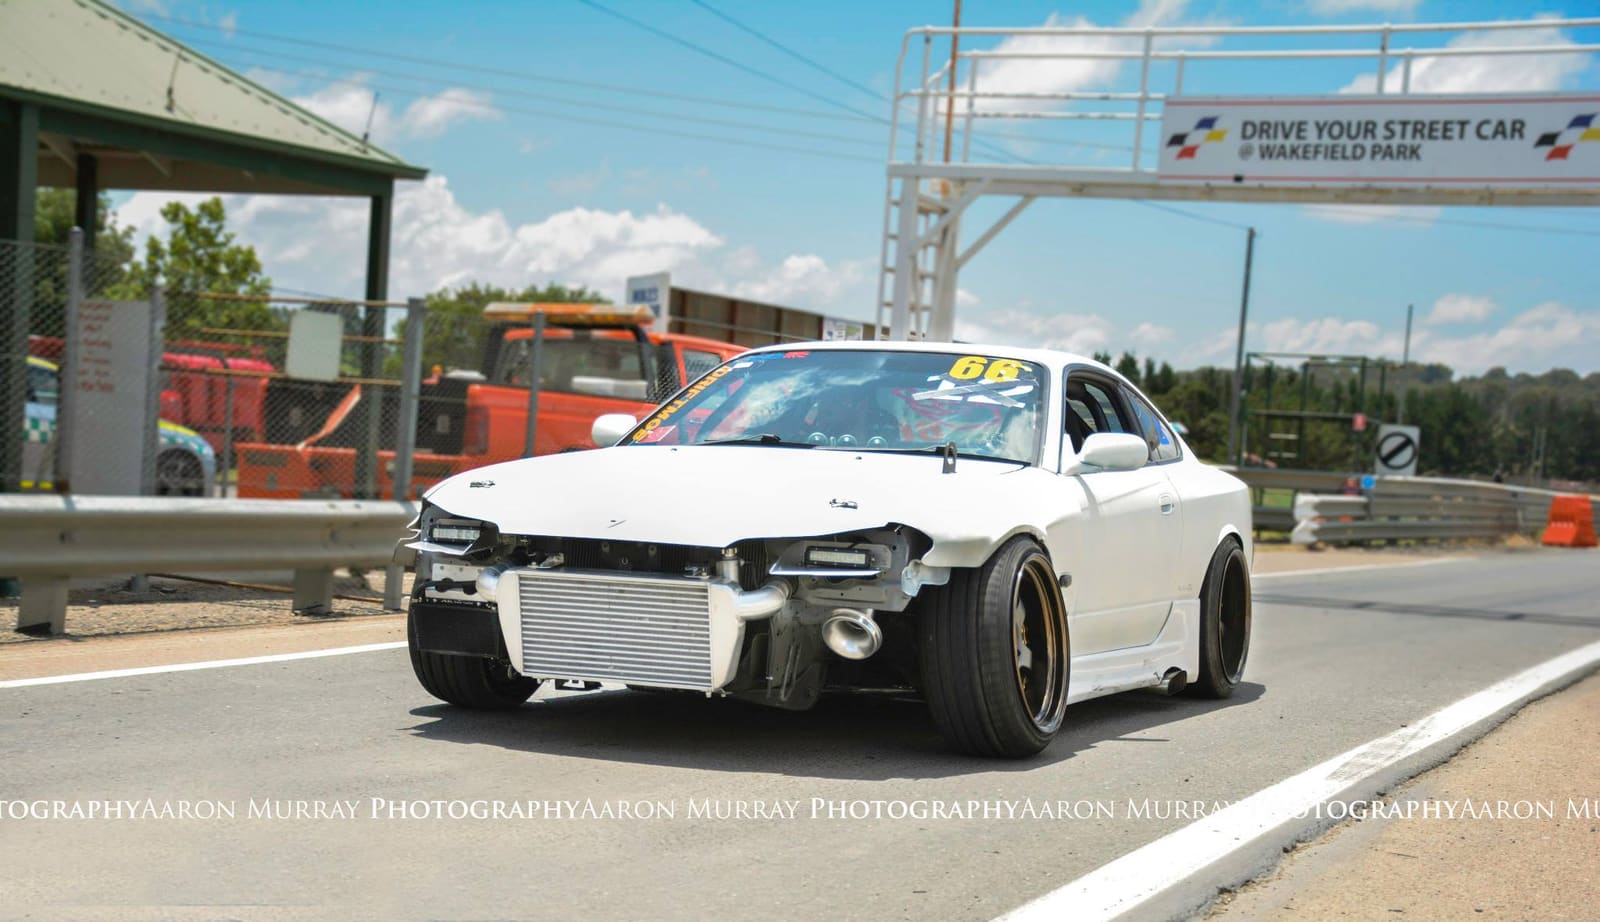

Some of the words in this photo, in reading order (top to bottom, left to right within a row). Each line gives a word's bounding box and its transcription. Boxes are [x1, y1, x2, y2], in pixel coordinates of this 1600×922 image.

[1240, 120, 1308, 140] DRIVE
[1315, 120, 1375, 140] YOUR
[1382, 119, 1470, 140] STREET
[1475, 119, 1526, 140] CAR
[1258, 143, 1365, 161] WAKEFIELD
[1370, 143, 1422, 161] PARK
[949, 356, 1021, 382] 66
